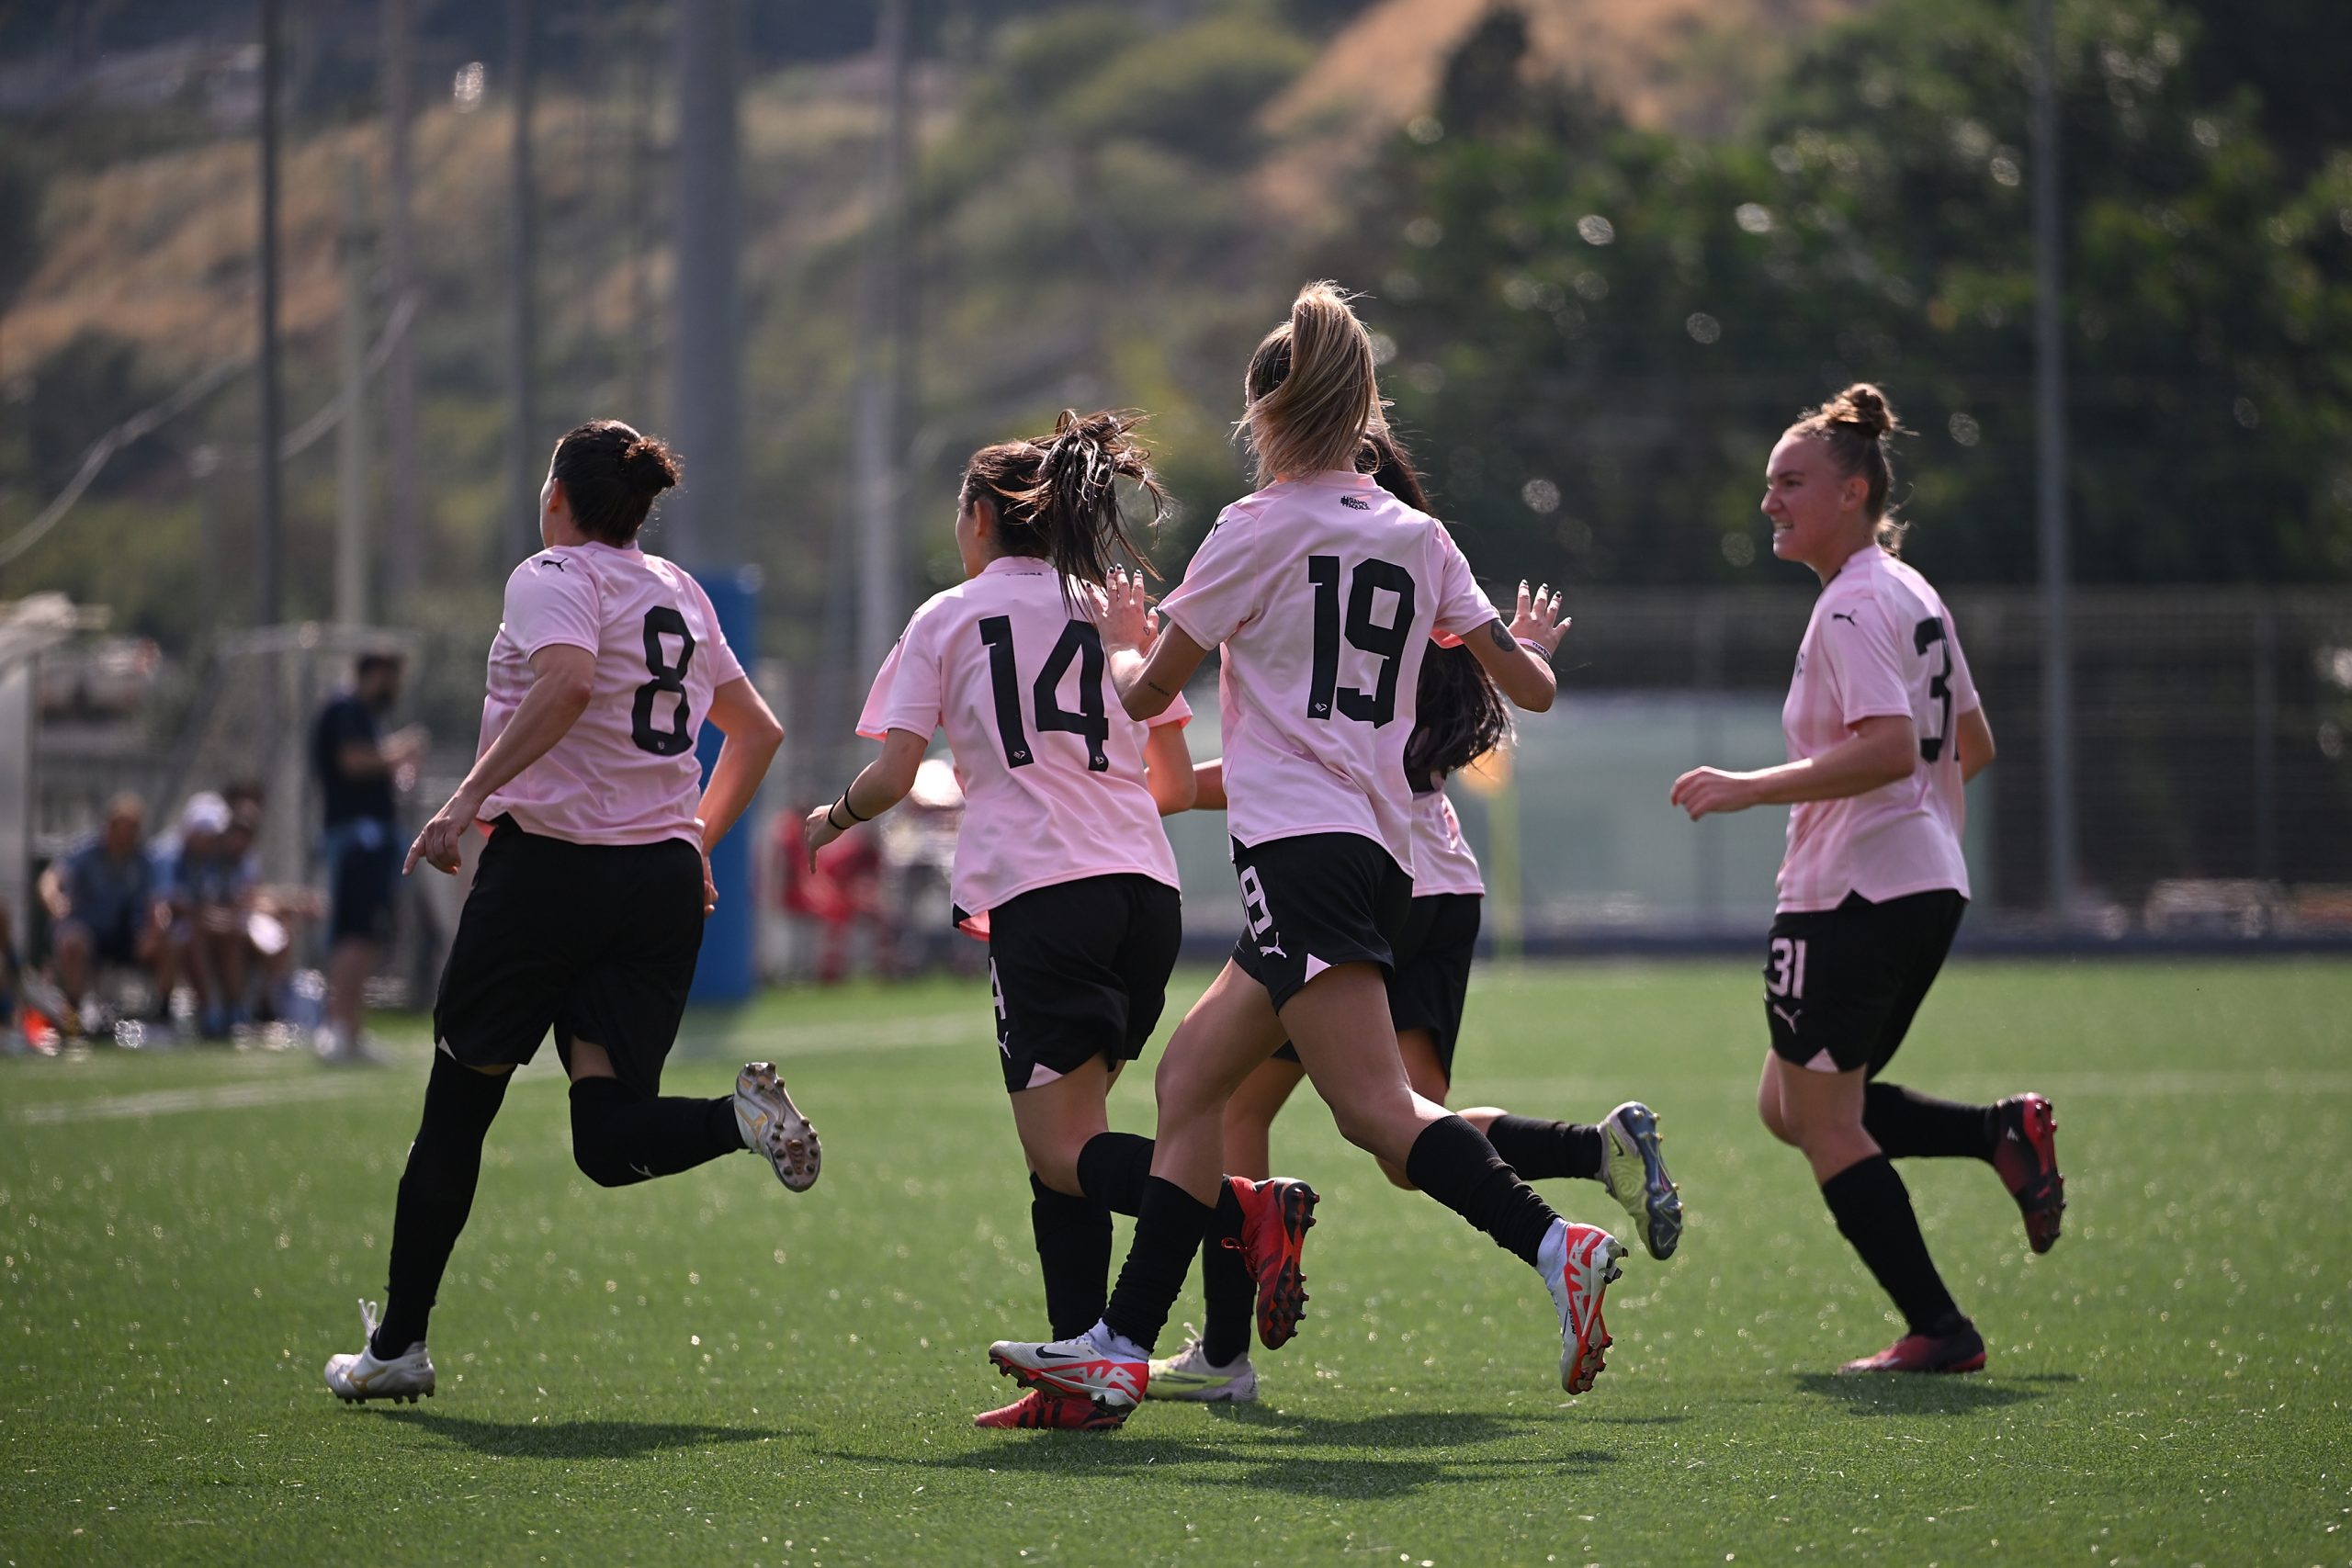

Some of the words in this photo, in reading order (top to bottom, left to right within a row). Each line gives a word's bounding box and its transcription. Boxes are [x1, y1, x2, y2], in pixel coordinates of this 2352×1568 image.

[631, 605, 695, 756] 8
[978, 615, 1109, 772] 14
[1307, 555, 1416, 729] 19
[1913, 616, 1960, 763] 3
[1766, 937, 1807, 999] 31
